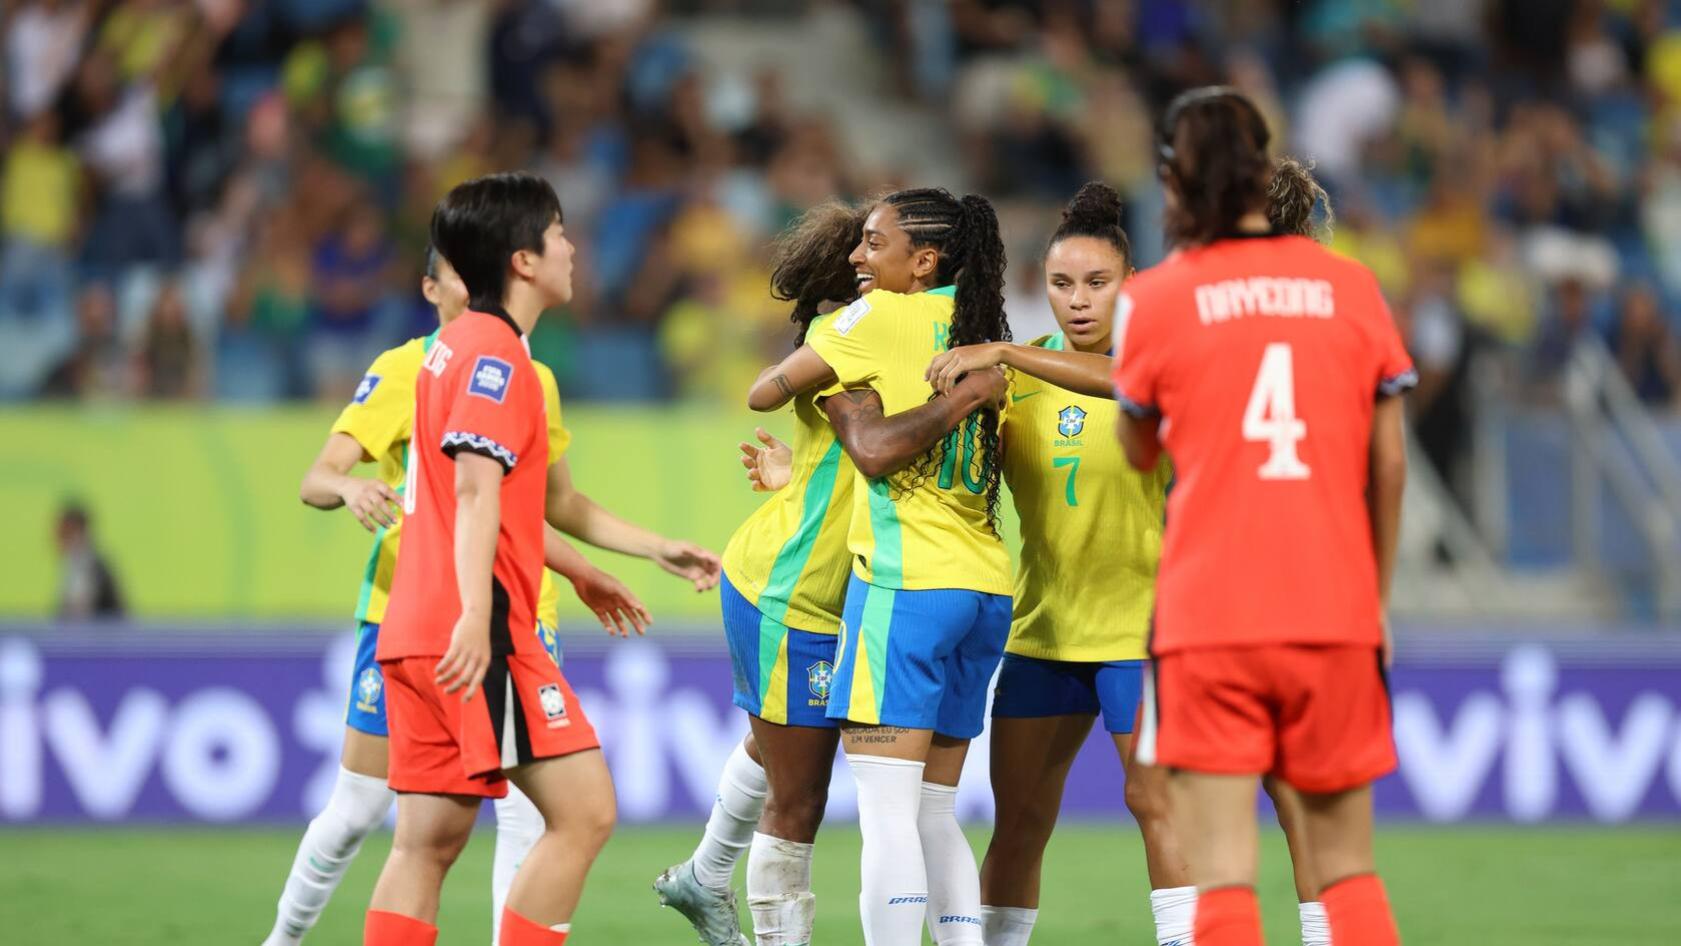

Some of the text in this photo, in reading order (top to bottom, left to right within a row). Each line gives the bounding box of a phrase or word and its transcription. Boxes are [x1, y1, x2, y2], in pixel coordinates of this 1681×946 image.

[936, 411, 994, 494] 10
[1242, 342, 1311, 480] 4
[1052, 456, 1081, 507] 7
[0, 637, 281, 822] ivo
[1391, 645, 1681, 823] viv
[888, 896, 928, 905] BRAS
[939, 915, 981, 925] BRAS
